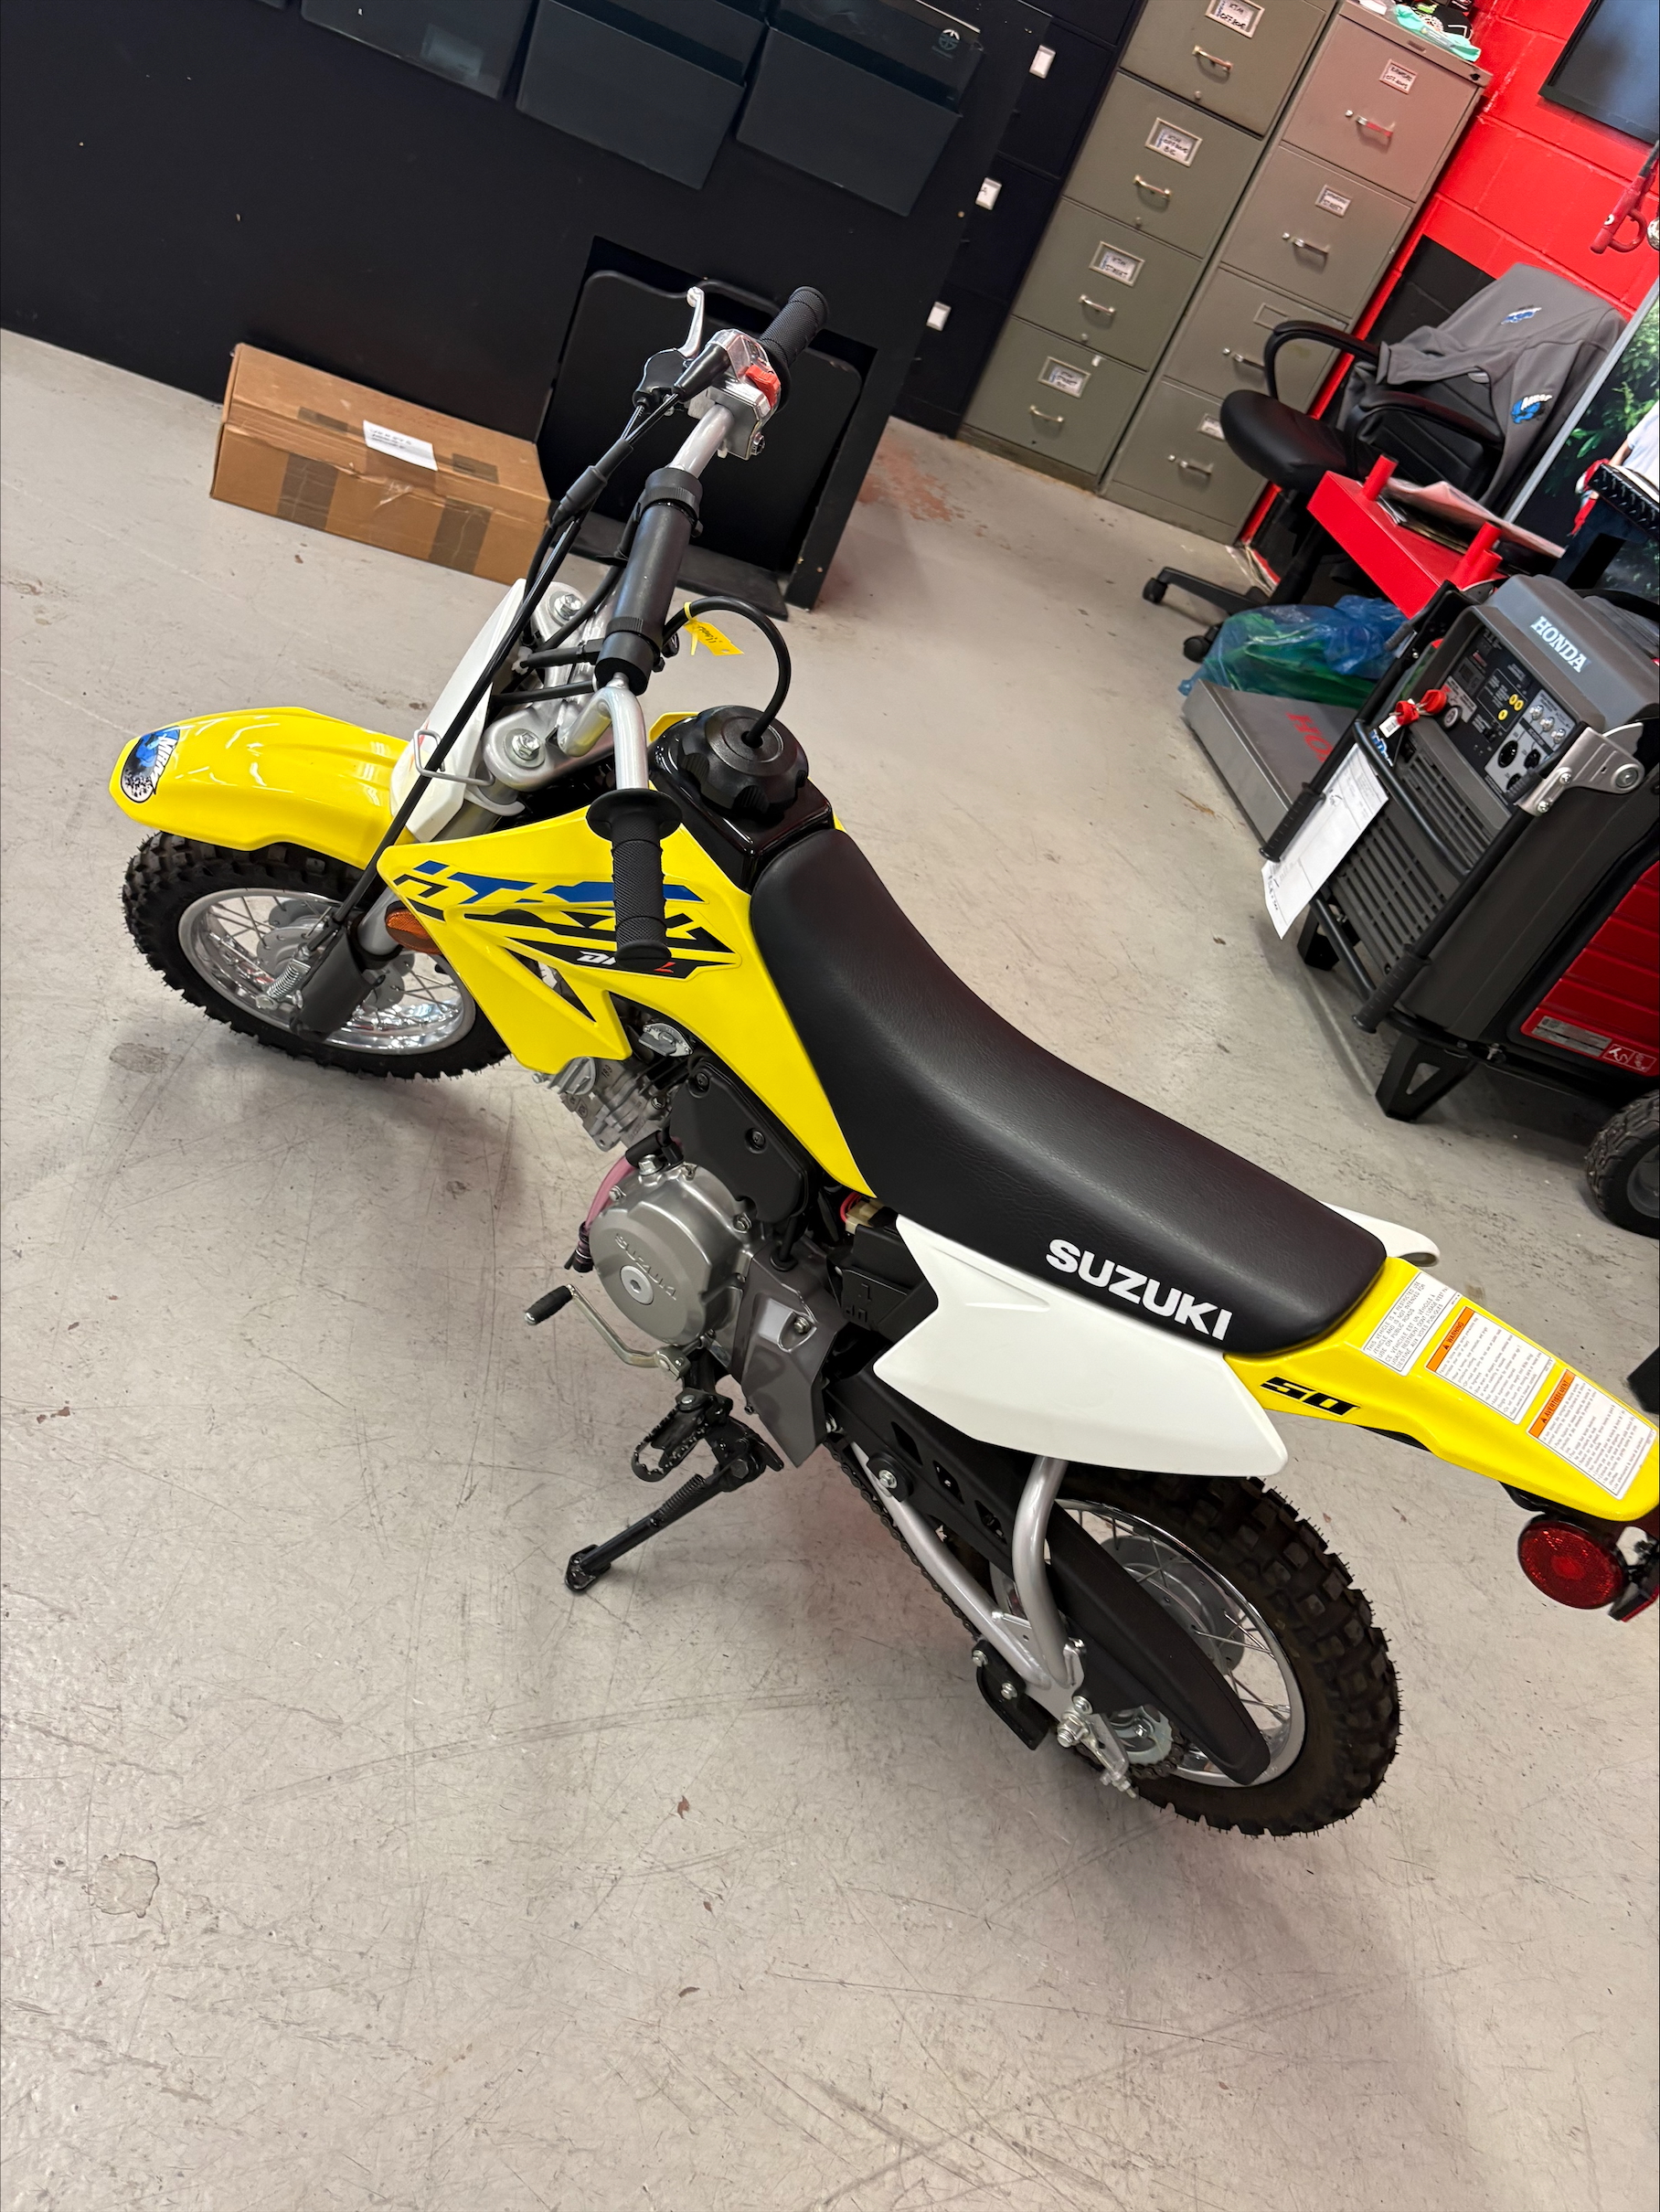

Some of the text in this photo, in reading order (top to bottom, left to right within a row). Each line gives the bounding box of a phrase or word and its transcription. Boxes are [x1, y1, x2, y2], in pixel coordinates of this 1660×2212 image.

[1530, 616, 1587, 673] HONDA
[614, 1232, 677, 1302] SUZUKI
[1046, 1239, 1233, 1341] SUZUKI
[1445, 1320, 1464, 1344] WARNING
[1259, 1377, 1361, 1416] 50
[1541, 1378, 1571, 1418] AVERTISSEMENT
